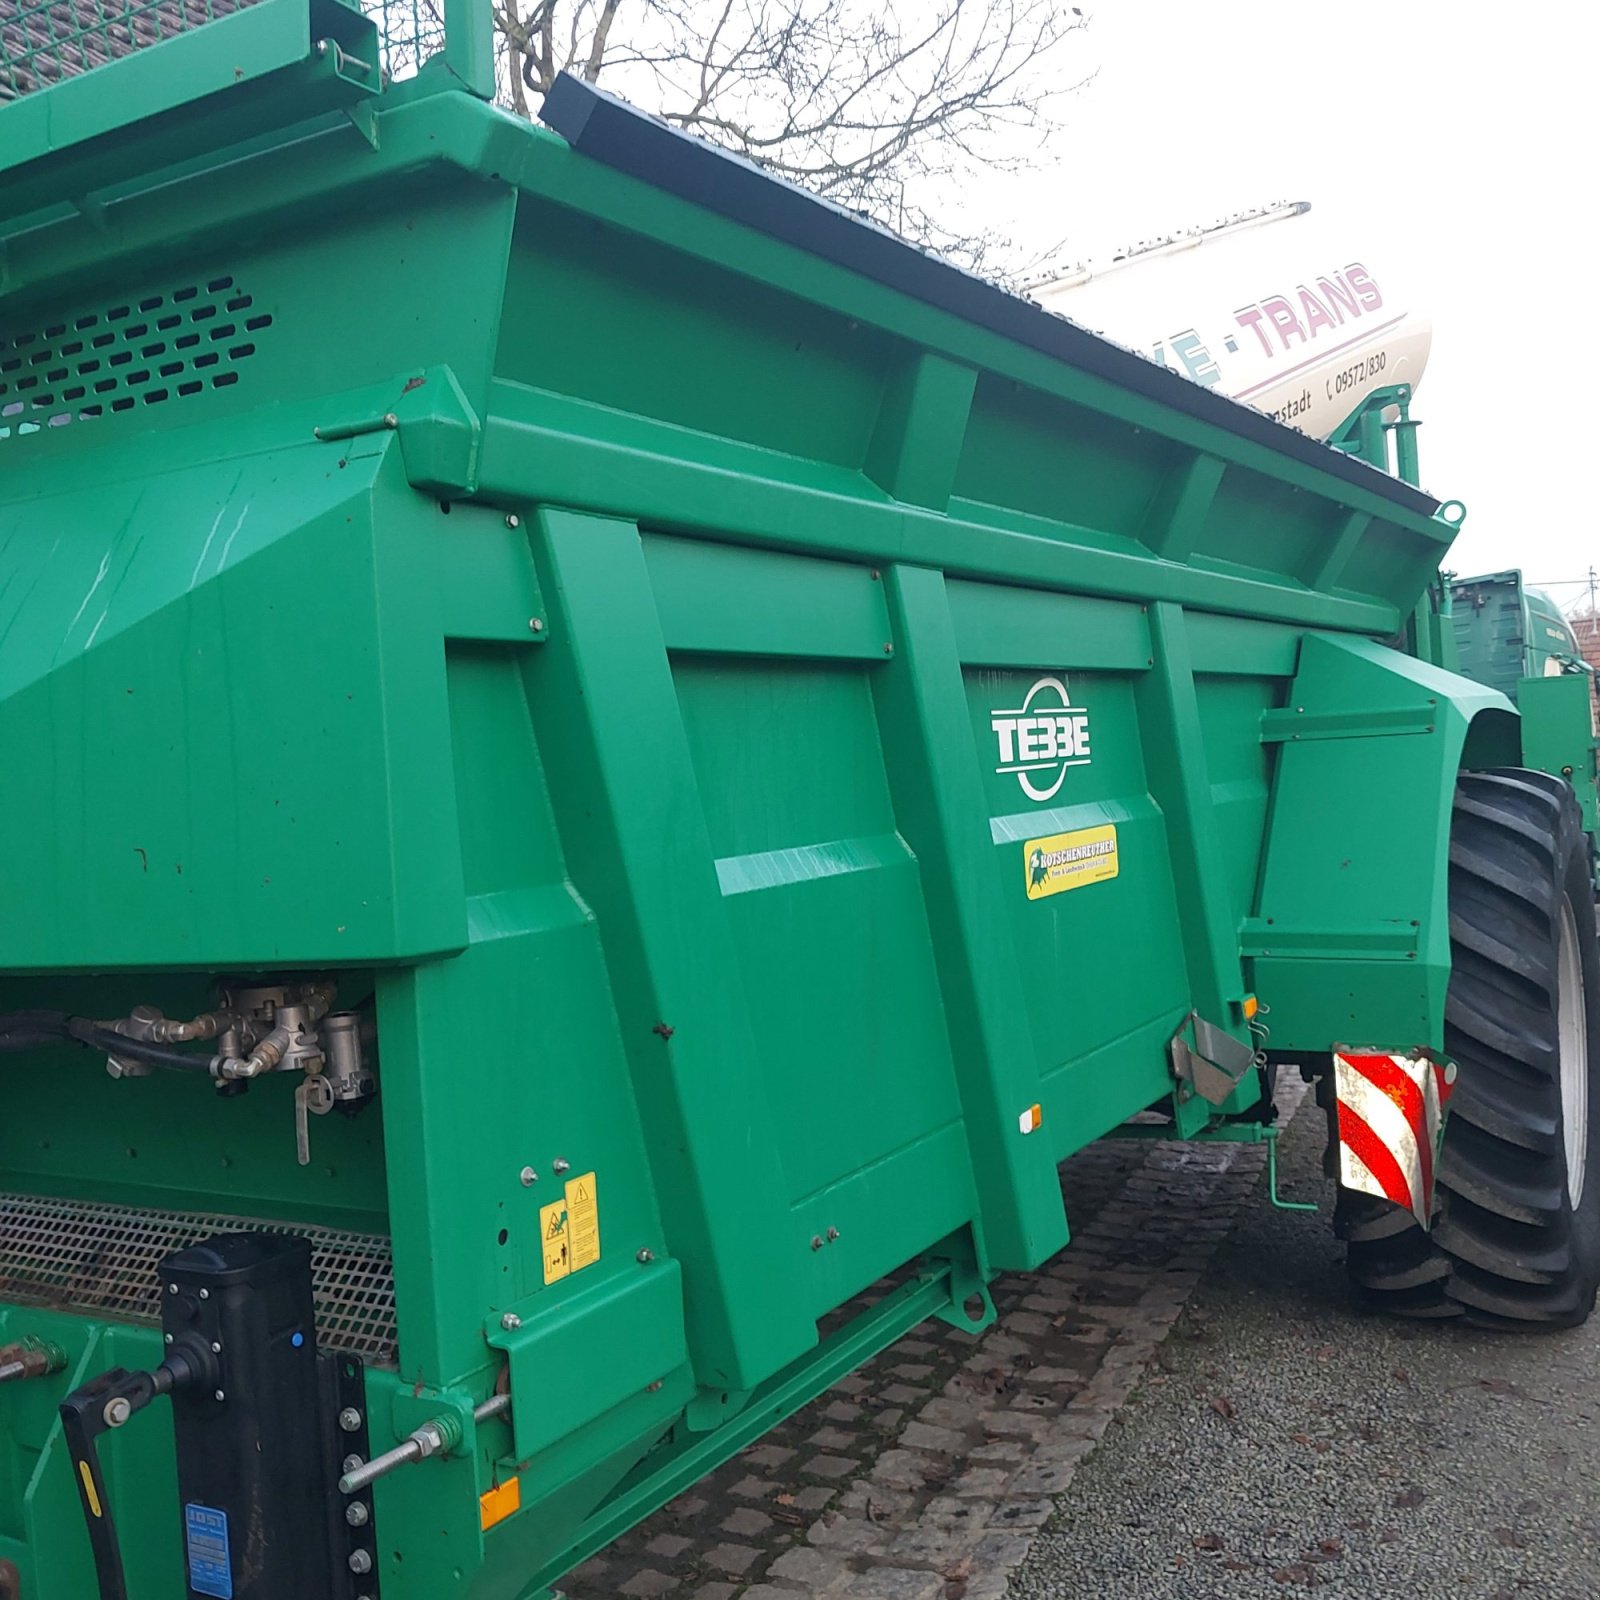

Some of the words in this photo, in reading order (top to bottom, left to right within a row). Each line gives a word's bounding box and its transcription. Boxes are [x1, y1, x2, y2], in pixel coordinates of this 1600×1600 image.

[1233, 263, 1383, 358] TRANS
[1272, 388, 1311, 422] nstadt
[1335, 351, 1386, 394] 09572/830
[991, 716, 1090, 763] TEBBE
[1041, 840, 1115, 869] KOTSCHENREUTHER
